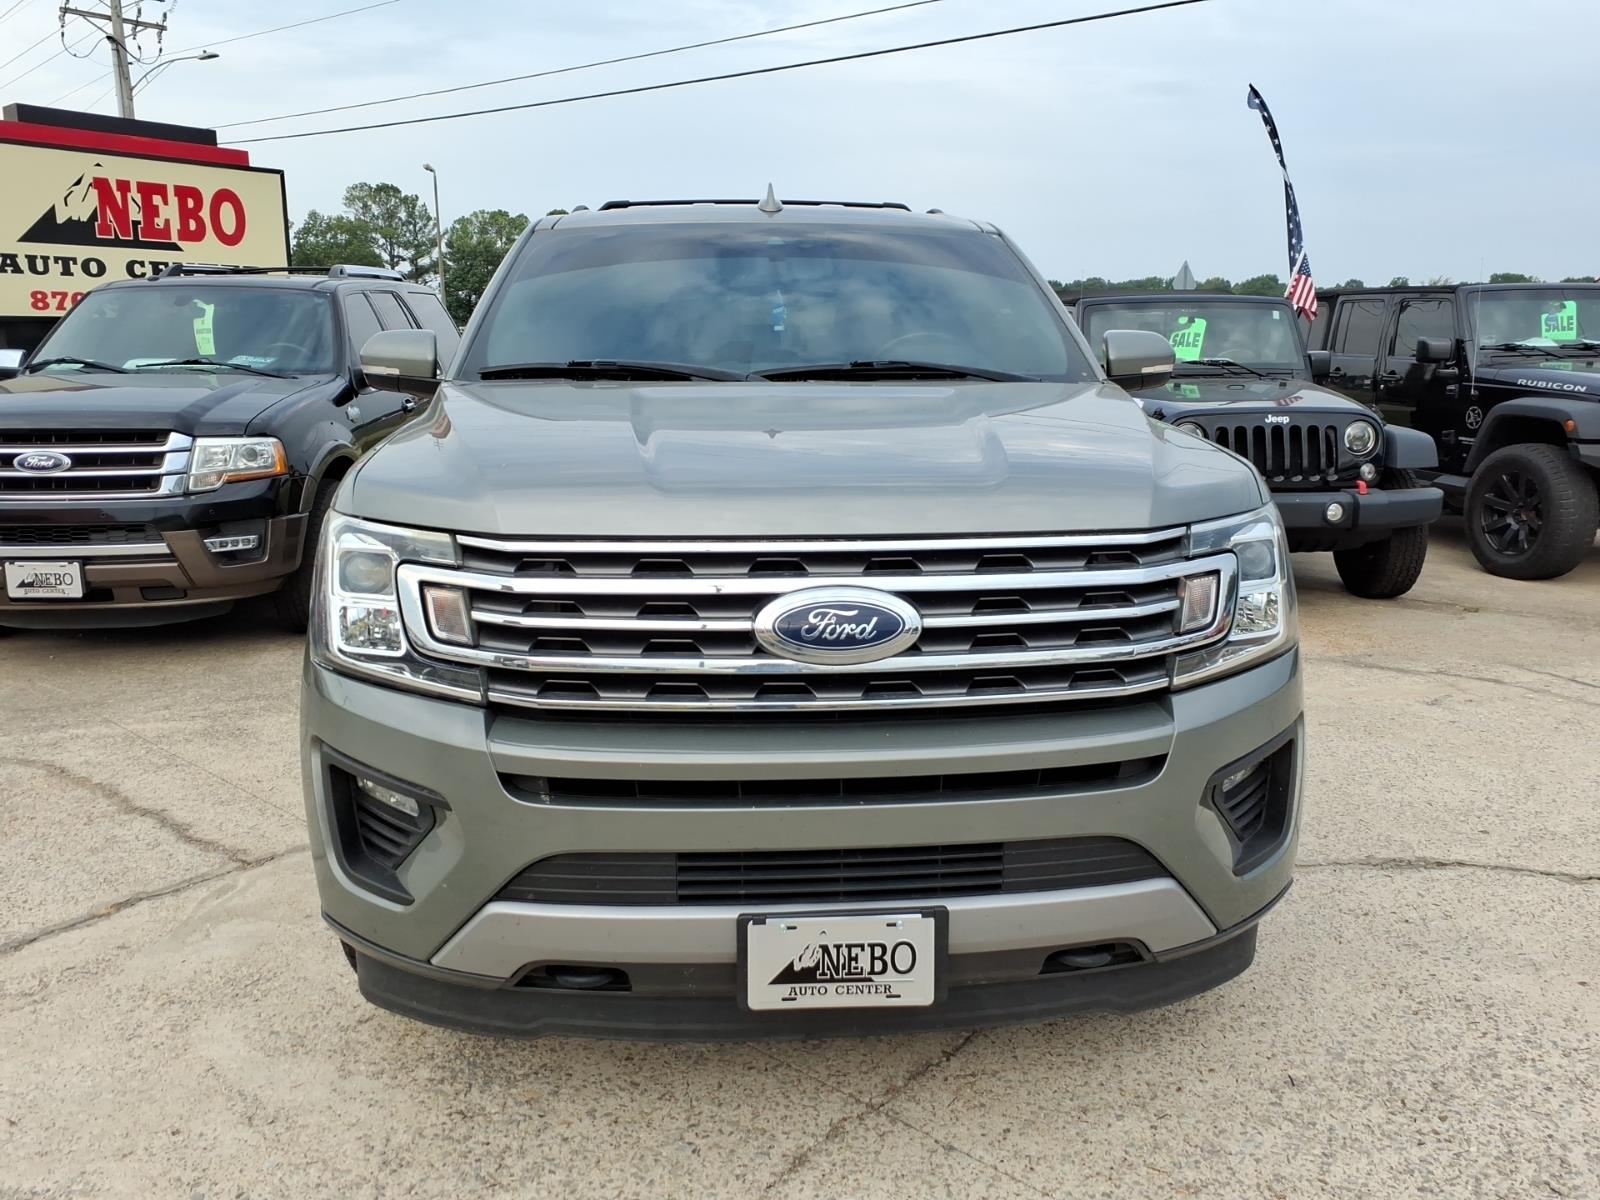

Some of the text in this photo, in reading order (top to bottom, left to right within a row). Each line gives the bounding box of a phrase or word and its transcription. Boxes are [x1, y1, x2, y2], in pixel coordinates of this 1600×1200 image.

[92, 176, 247, 247] NEBO
[0, 253, 107, 278] AUTO
[1544, 315, 1574, 333] SALE
[1172, 332, 1201, 348] SALE
[1517, 378, 1588, 393] RUBICON
[1265, 414, 1290, 425] Jeep
[24, 455, 55, 468] Ford
[34, 572, 74, 586] NEBO
[801, 609, 878, 640] Ford
[817, 940, 917, 977] NEBO
[788, 983, 893, 997] AUTO CENTER
